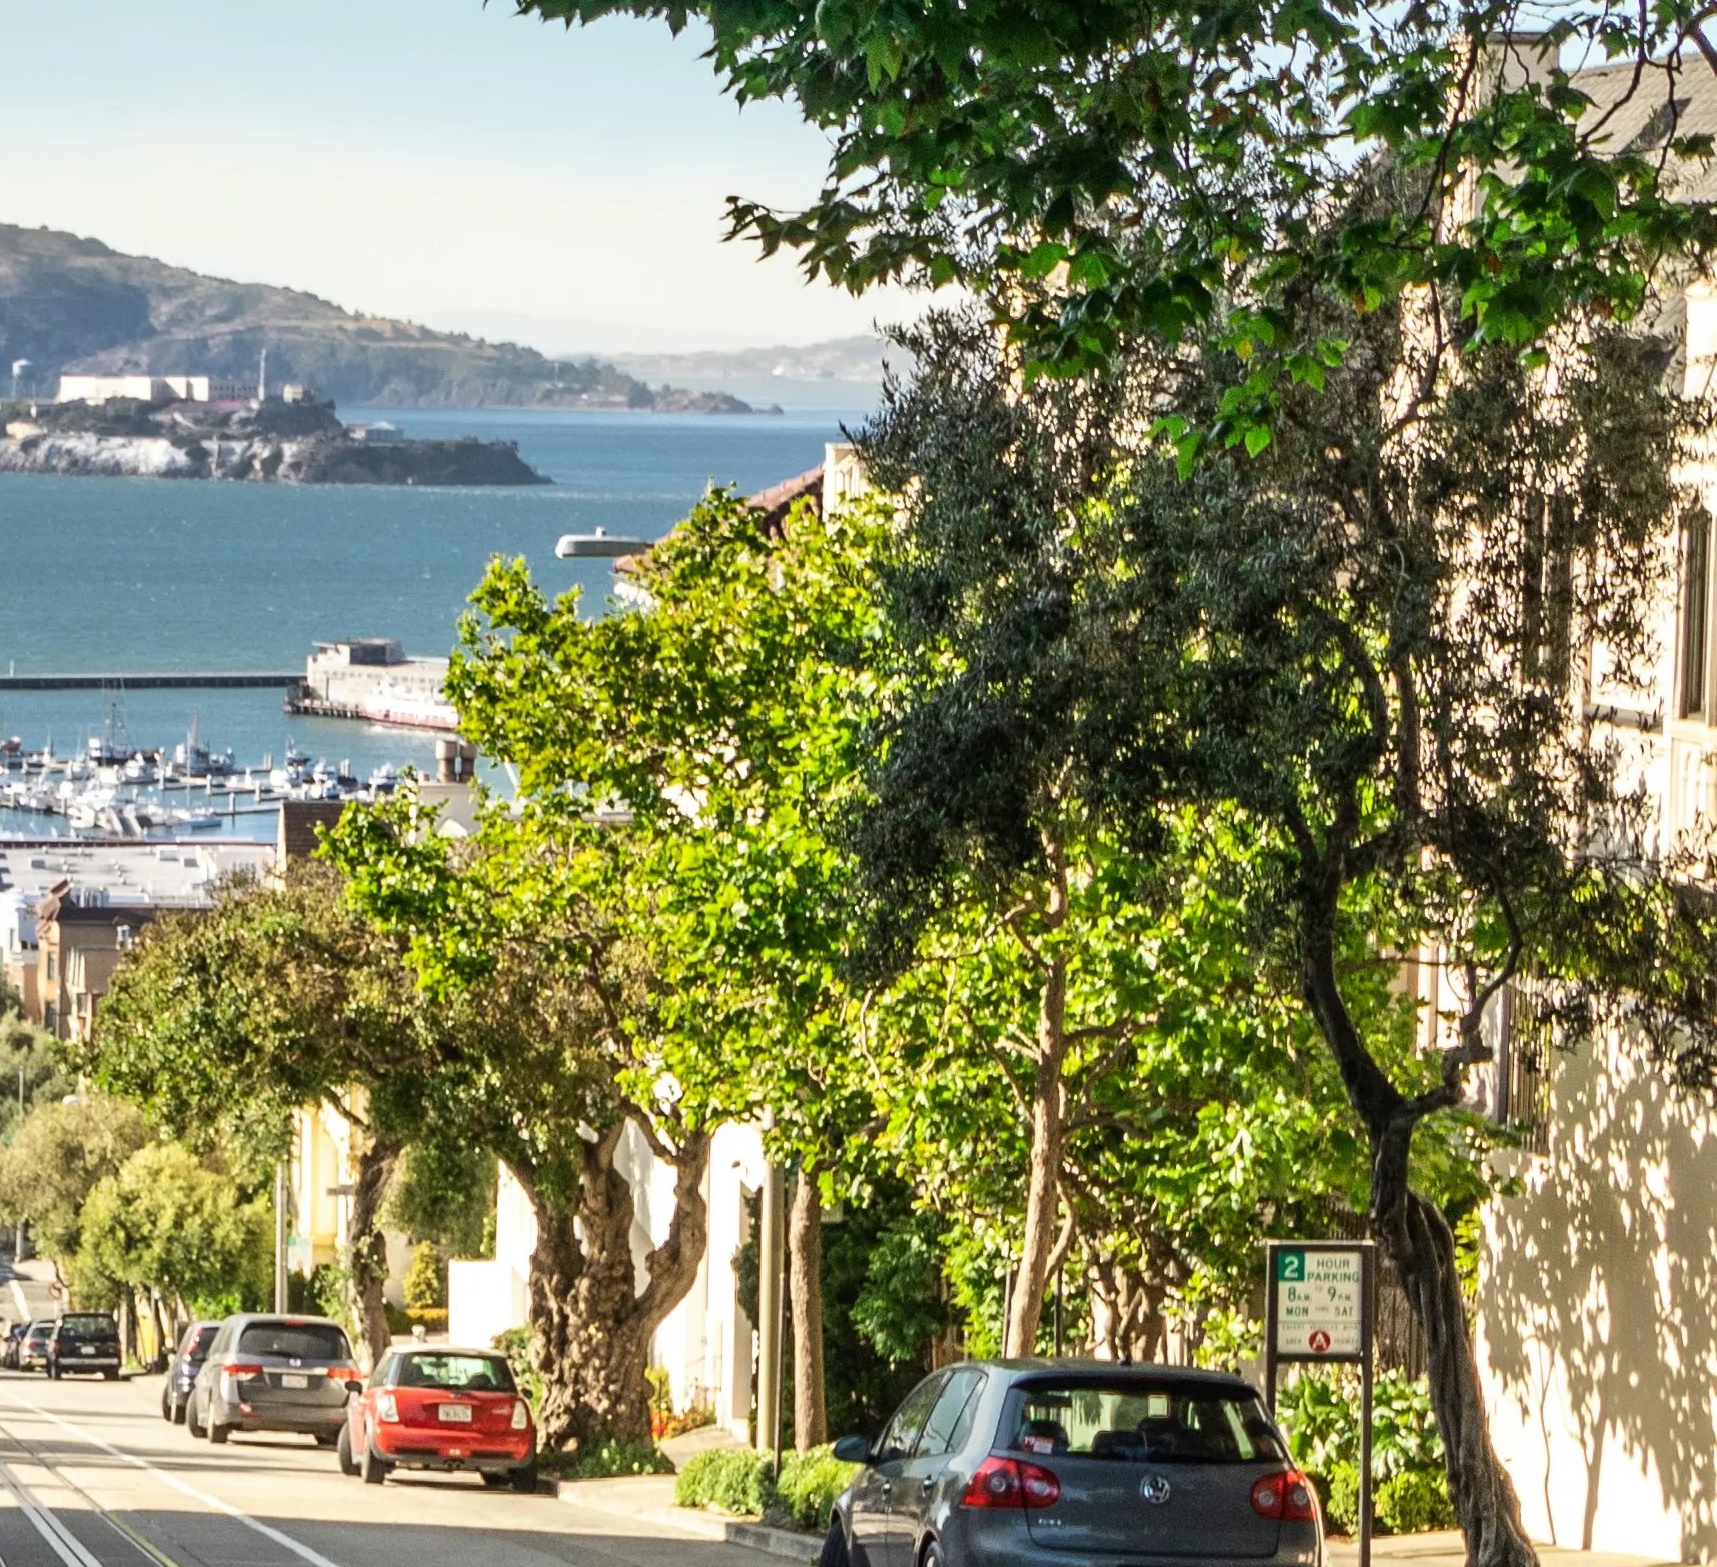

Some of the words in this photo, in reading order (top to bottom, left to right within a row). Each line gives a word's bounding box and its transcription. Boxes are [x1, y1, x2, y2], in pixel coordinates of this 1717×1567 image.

[1284, 1255, 1299, 1278] 2
[1316, 1259, 1350, 1270] HOUR
[1307, 1271, 1360, 1282] PARKING
[1285, 1307, 1309, 1316] MON
[1334, 1306, 1353, 1317] SAT
[1312, 1333, 1328, 1350] A
